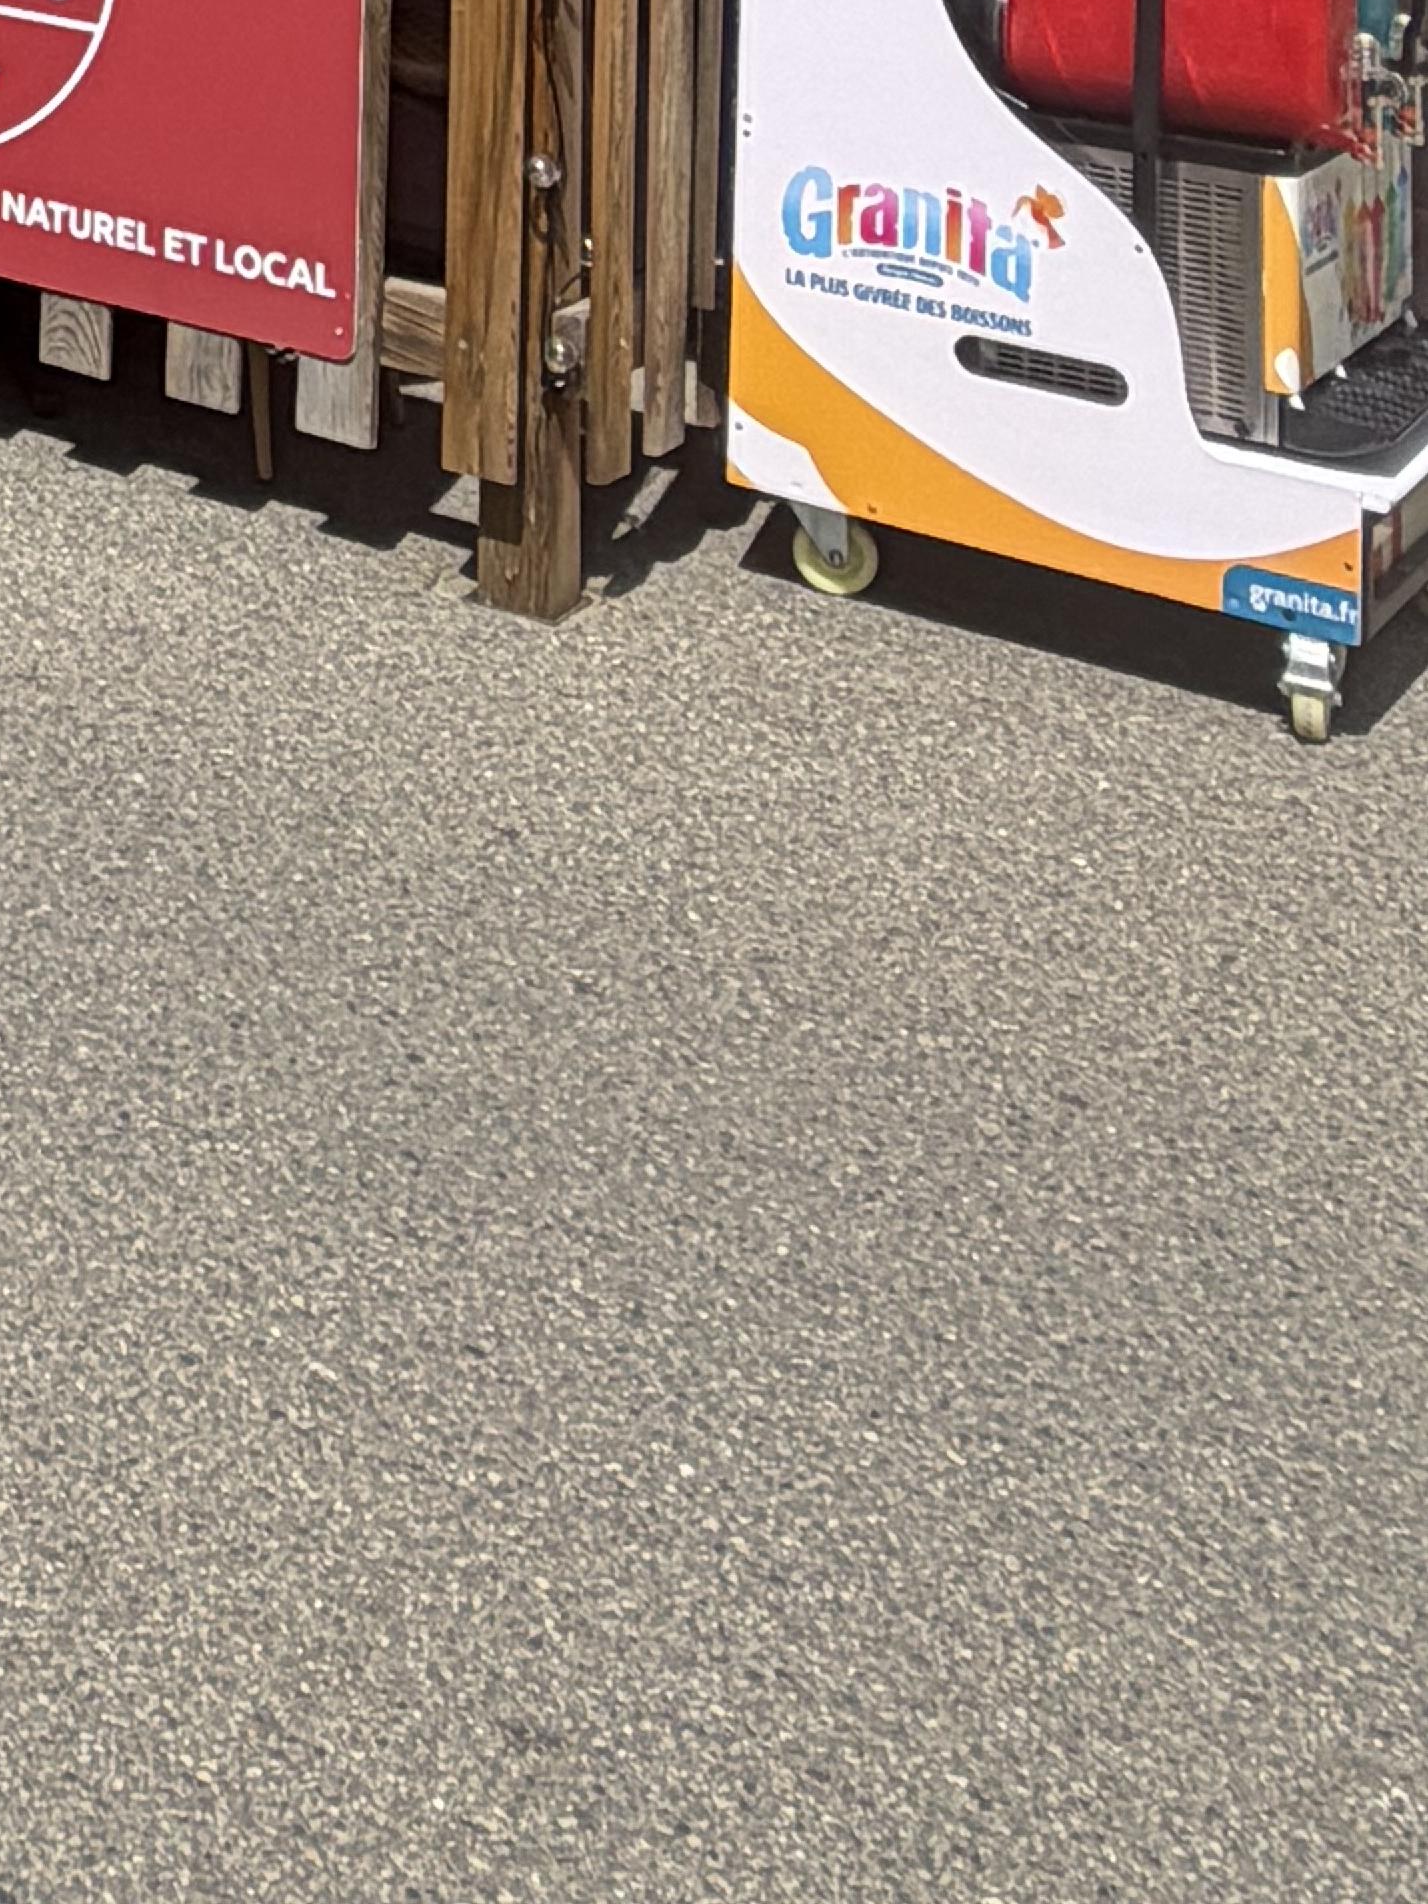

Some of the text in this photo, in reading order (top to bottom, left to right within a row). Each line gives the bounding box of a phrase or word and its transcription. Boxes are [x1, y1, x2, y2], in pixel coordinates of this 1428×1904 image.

[0, 189, 337, 300] NATUREL ET LOCAL
[782, 165, 1033, 304] Granita
[785, 267, 806, 288] LA
[810, 272, 850, 298] PLUS
[915, 296, 946, 320] DES
[950, 303, 1033, 338] BOISSONS
[1248, 583, 1359, 626] granita.fr
